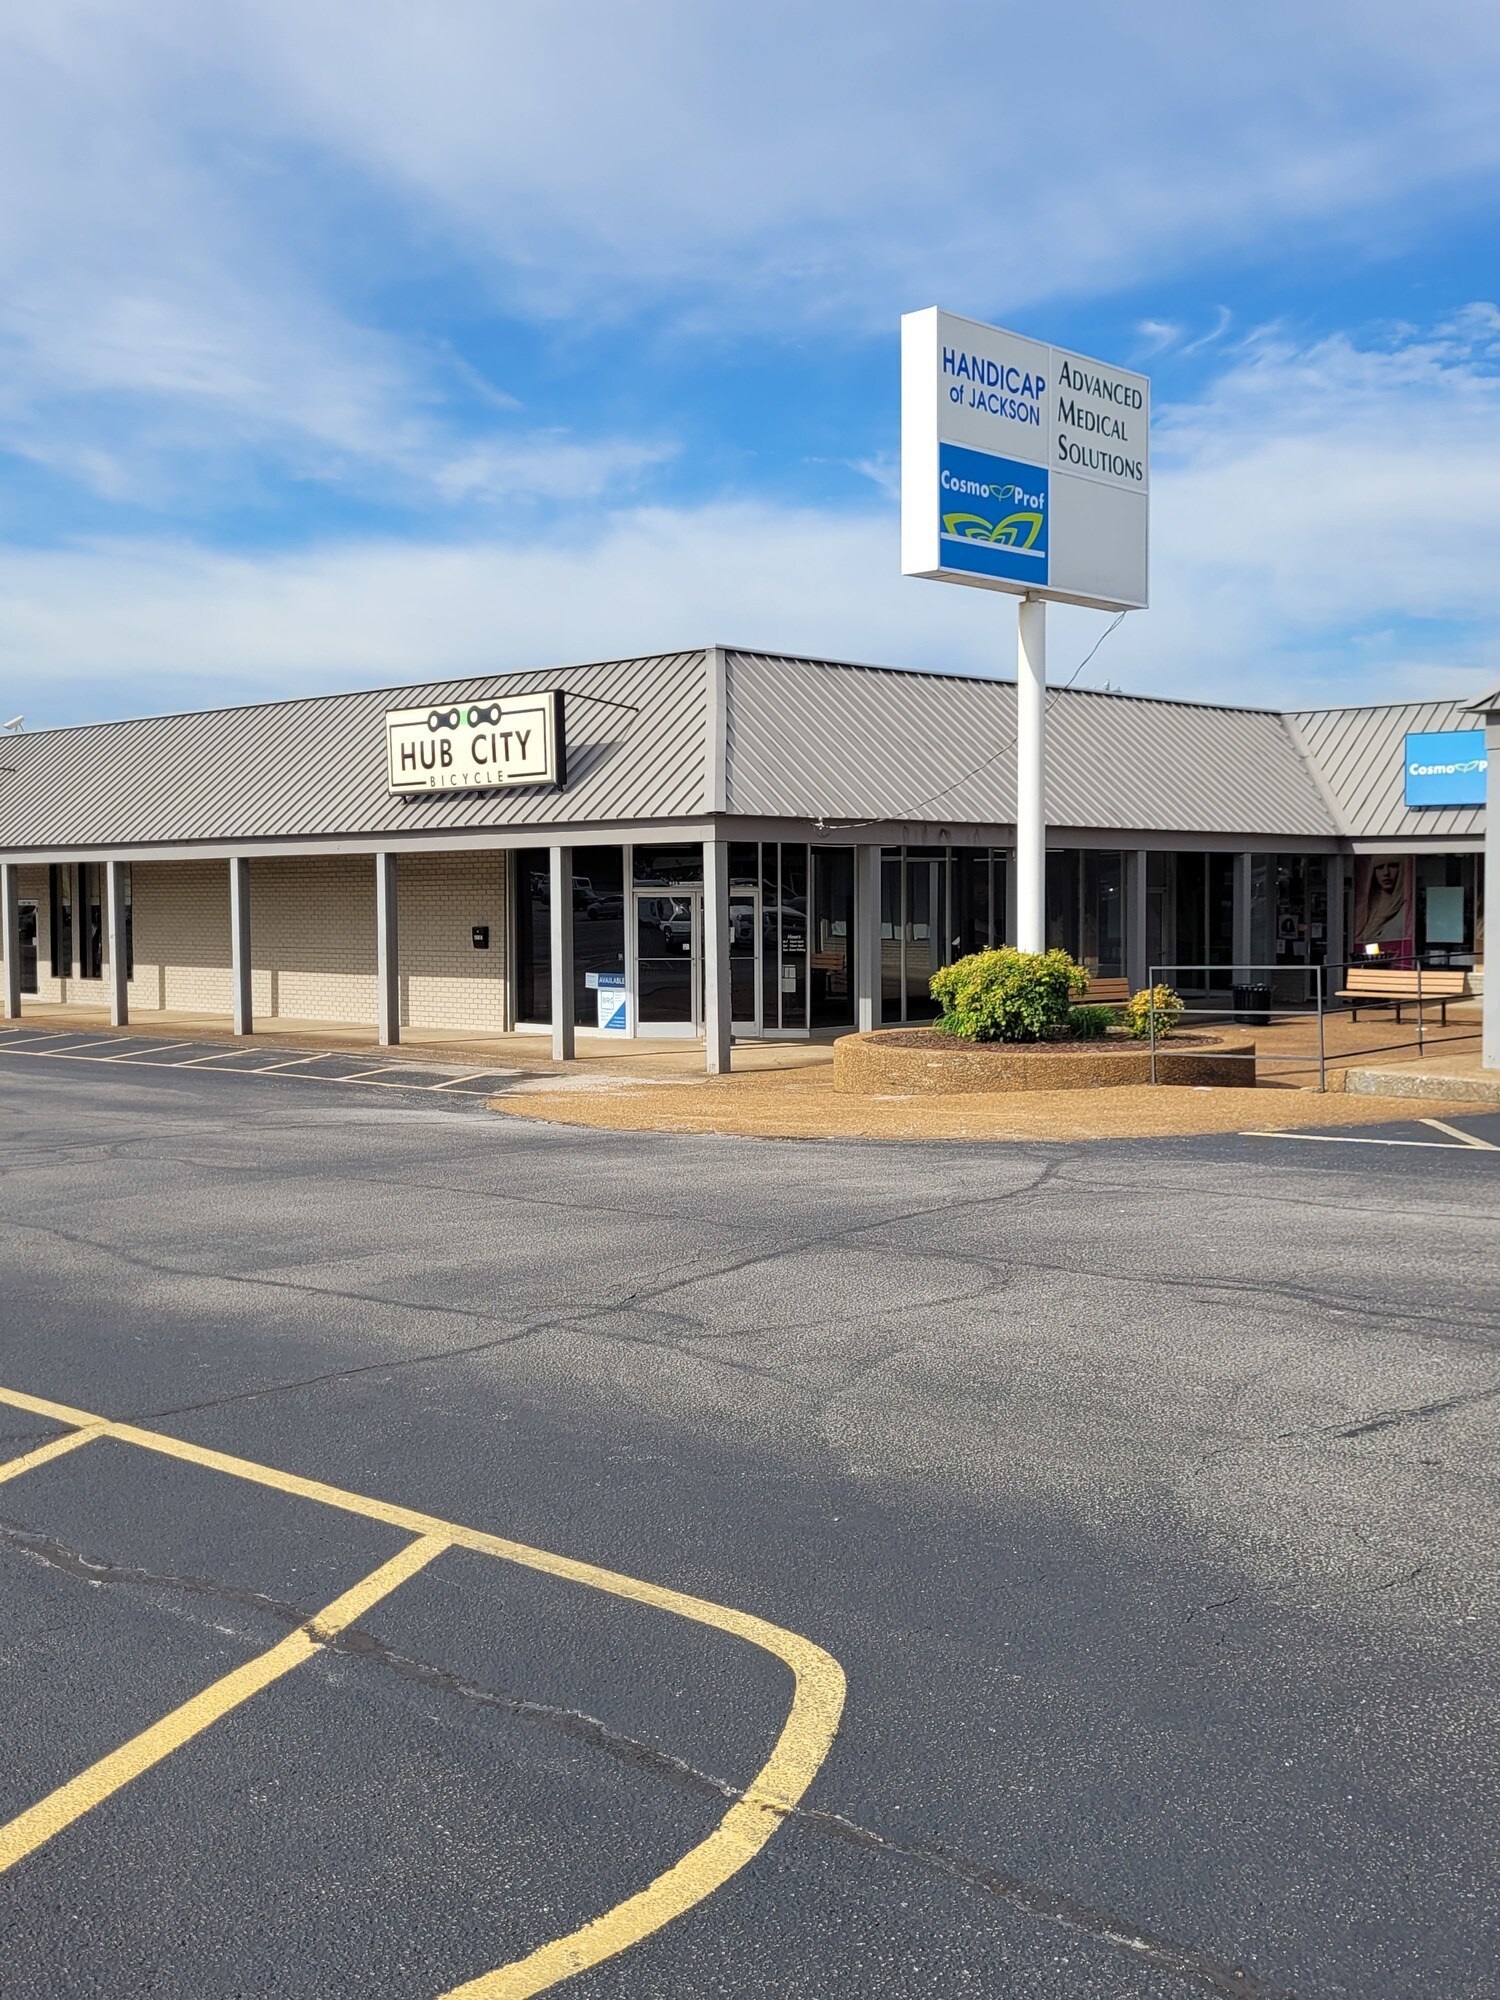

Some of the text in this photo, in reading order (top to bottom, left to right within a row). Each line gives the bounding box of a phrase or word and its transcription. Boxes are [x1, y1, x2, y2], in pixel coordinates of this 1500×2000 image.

[943, 346, 1046, 401] HANDICAP
[1058, 360, 1142, 410] ADVANCED
[949, 384, 1040, 427] of JACKSON
[1058, 396, 1128, 442] MEDICAL
[1058, 433, 1143, 481] SOLUTIONS
[941, 470, 1045, 510] Cosmo Prof
[401, 729, 532, 771] HUB CITY
[1409, 763, 1456, 776] Cosmo
[430, 770, 504, 788] BICYCLE
[599, 976, 625, 984] AVAILABLE
